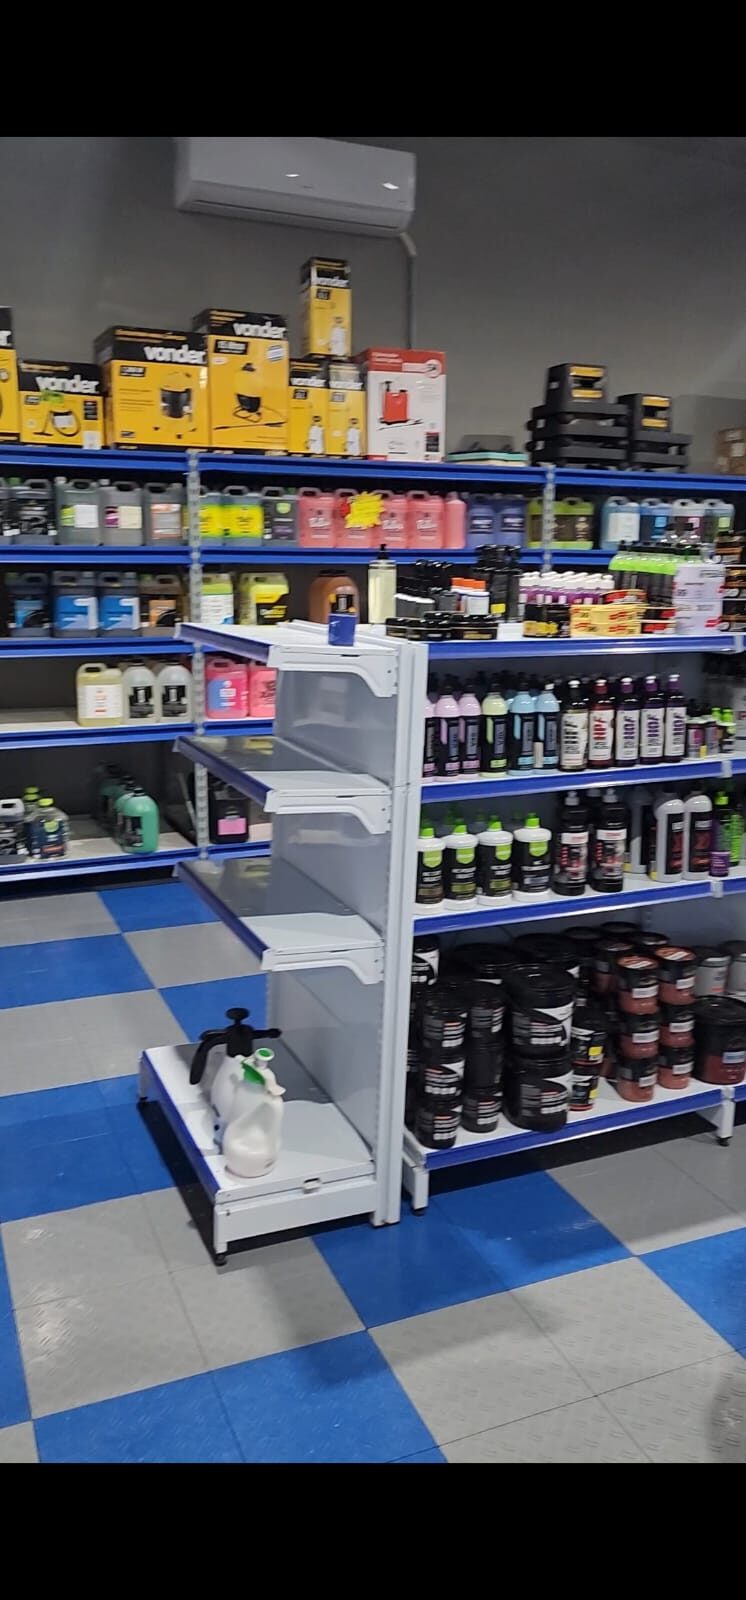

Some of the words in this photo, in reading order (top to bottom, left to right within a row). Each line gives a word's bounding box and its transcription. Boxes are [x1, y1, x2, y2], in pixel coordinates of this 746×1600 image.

[233, 321, 288, 340] vonder
[144, 344, 207, 365] vonder
[36, 375, 99, 394] vonder
